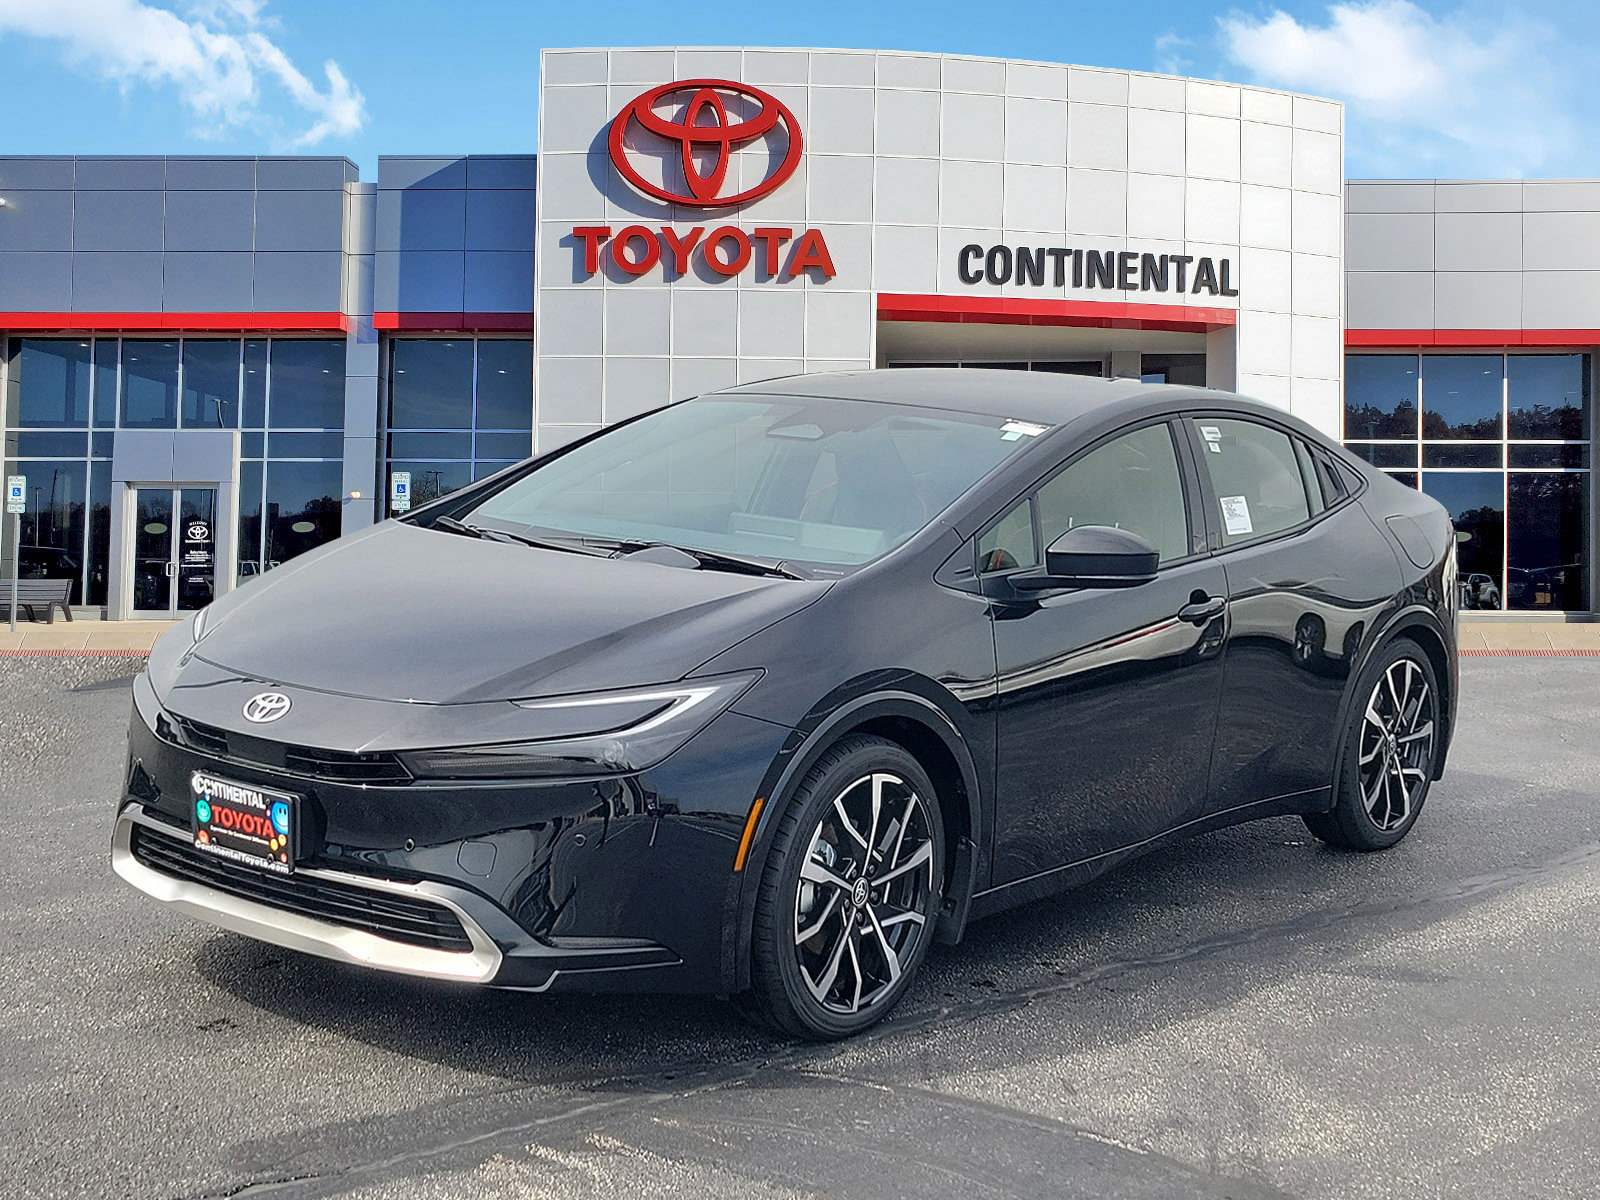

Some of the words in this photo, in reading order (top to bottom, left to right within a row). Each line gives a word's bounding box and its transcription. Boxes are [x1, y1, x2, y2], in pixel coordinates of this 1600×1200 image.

[573, 225, 836, 277] TOYOTA
[959, 244, 1239, 296] CONTINENTAL
[211, 805, 275, 839] TOYOTA
